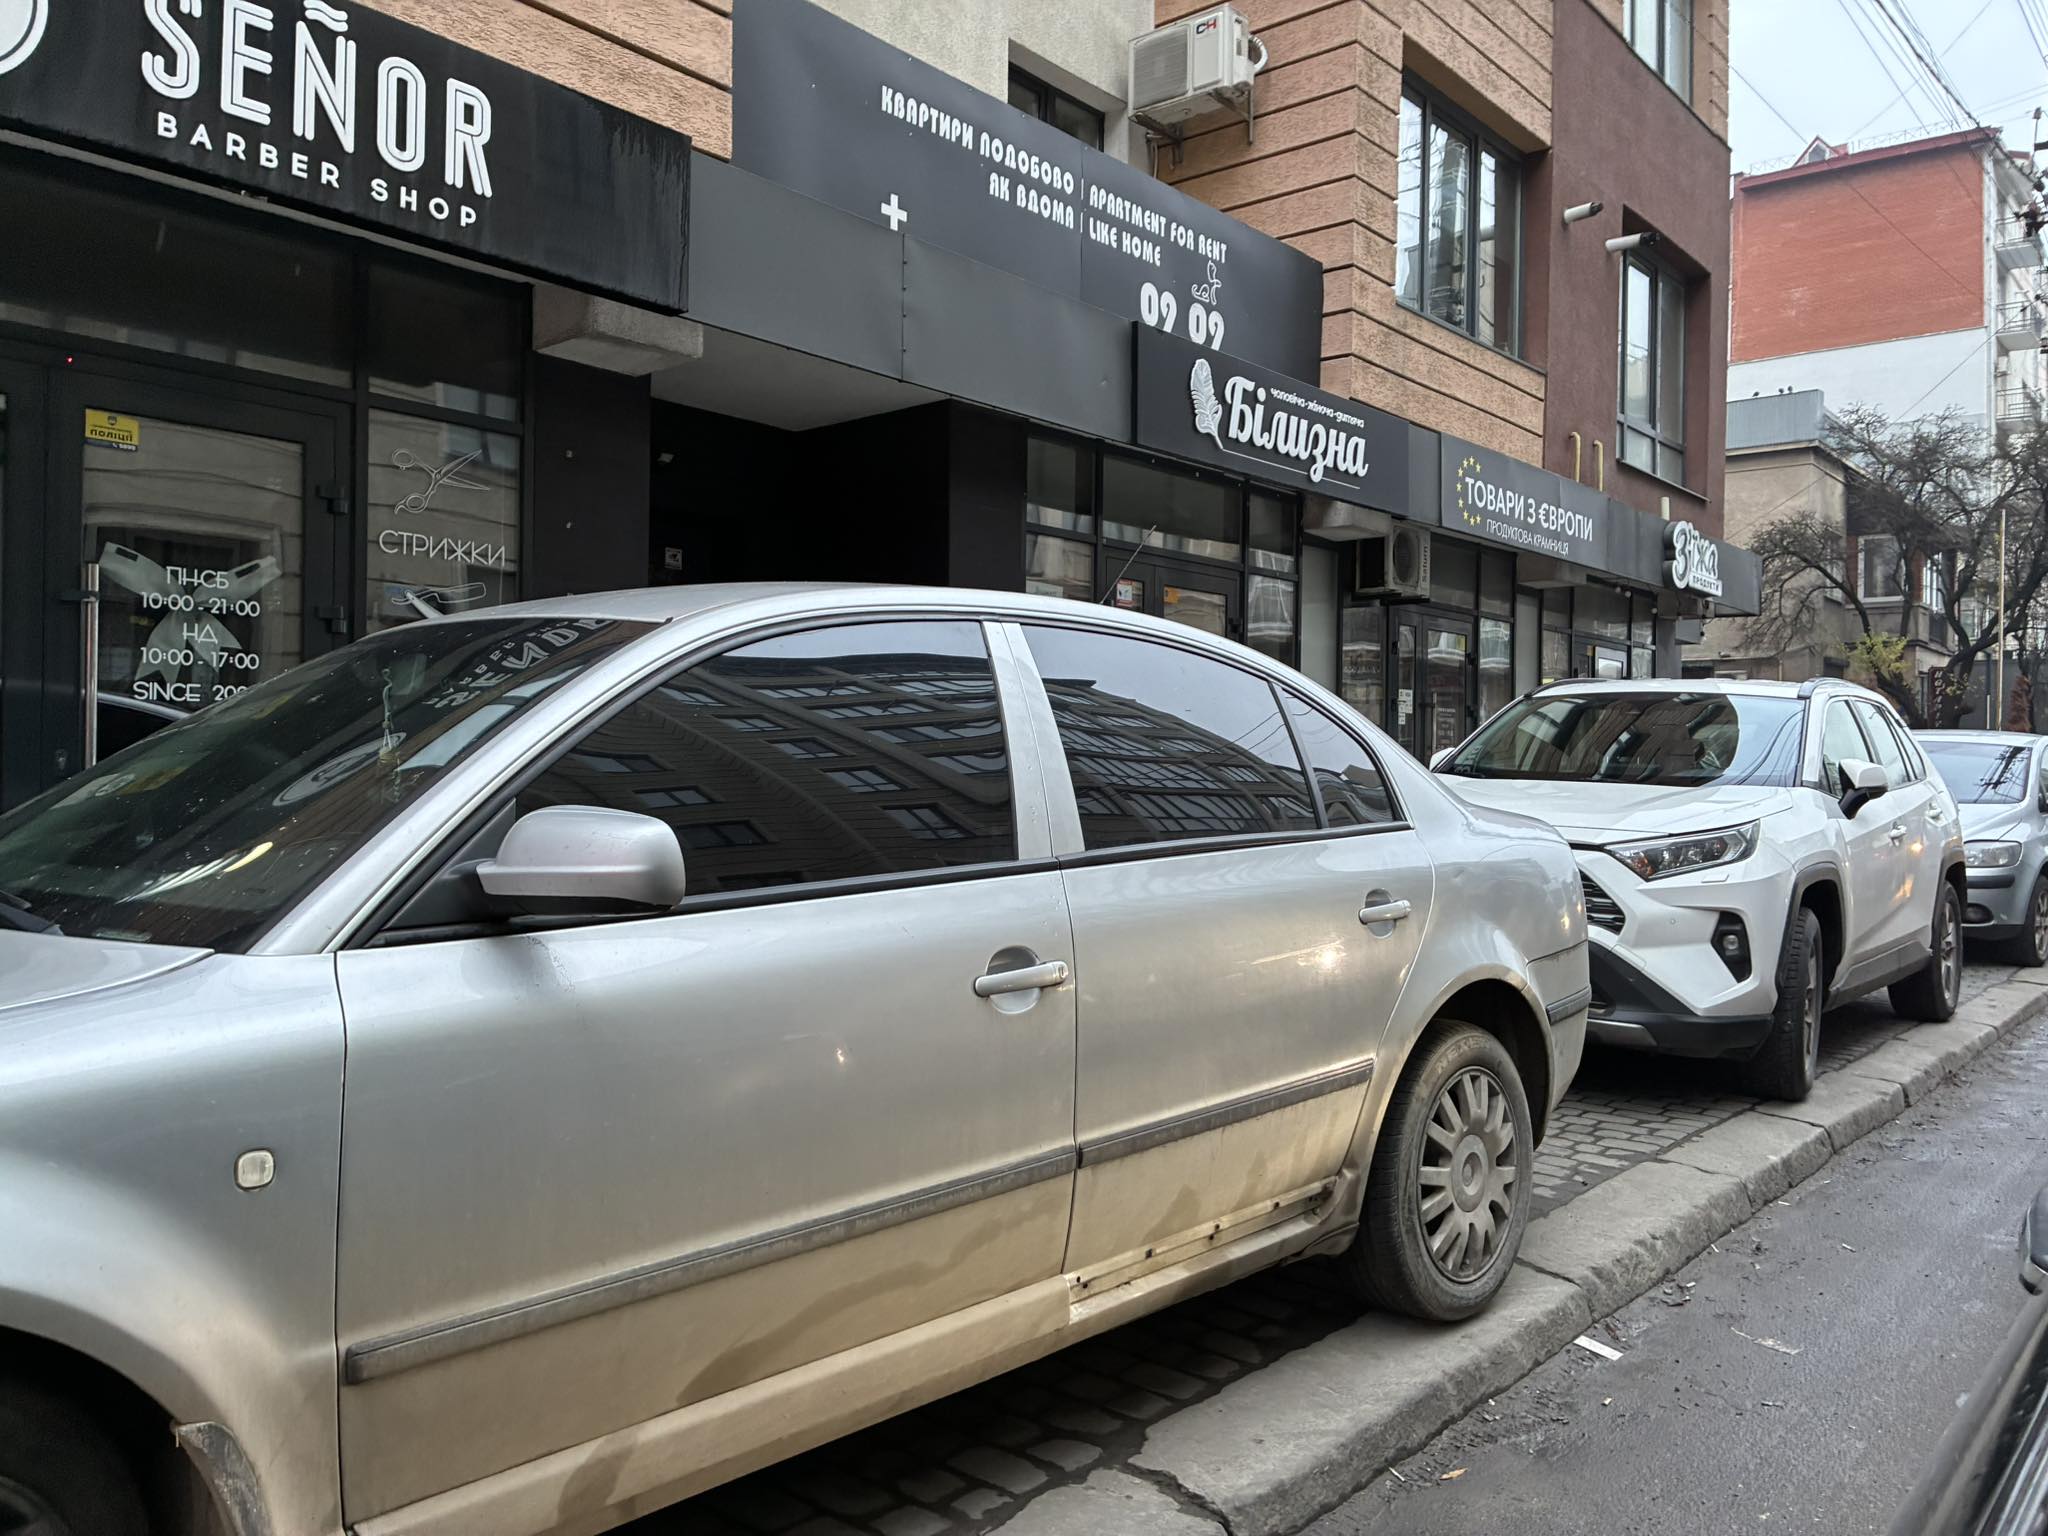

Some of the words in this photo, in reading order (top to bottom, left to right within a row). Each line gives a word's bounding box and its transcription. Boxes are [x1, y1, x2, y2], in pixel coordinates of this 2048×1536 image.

[141, 0, 493, 198] SEÑOR
[881, 85, 974, 150] КВАРТИРИ
[979, 132, 1075, 195] ПОДОБОВО
[157, 112, 341, 189] BARBER
[370, 178, 477, 227] SHOP
[989, 172, 1010, 202] ЯК
[1016, 184, 1075, 229] ВДОМА
[1089, 184, 1167, 238] APARTMENT
[1170, 222, 1195, 251] FOR
[1198, 234, 1228, 264] RENT
[1089, 217, 1118, 249] LIKE
[1122, 231, 1161, 267] HOME
[1224, 376, 1369, 483] Білизна
[1465, 477, 1524, 521] ТОВАРИ
[379, 530, 505, 567] СТРИЖКИ
[1486, 518, 1533, 545] ПРОДУКТОВА
[1533, 533, 1569, 557] КРАМНИЦЯ
[141, 592, 194, 612] 10:00
[208, 597, 261, 617] 21:00
[182, 622, 218, 644] НД
[140, 647, 194, 666] 10:00
[210, 652, 260, 670] 17:00
[133, 681, 201, 702] SINCE
